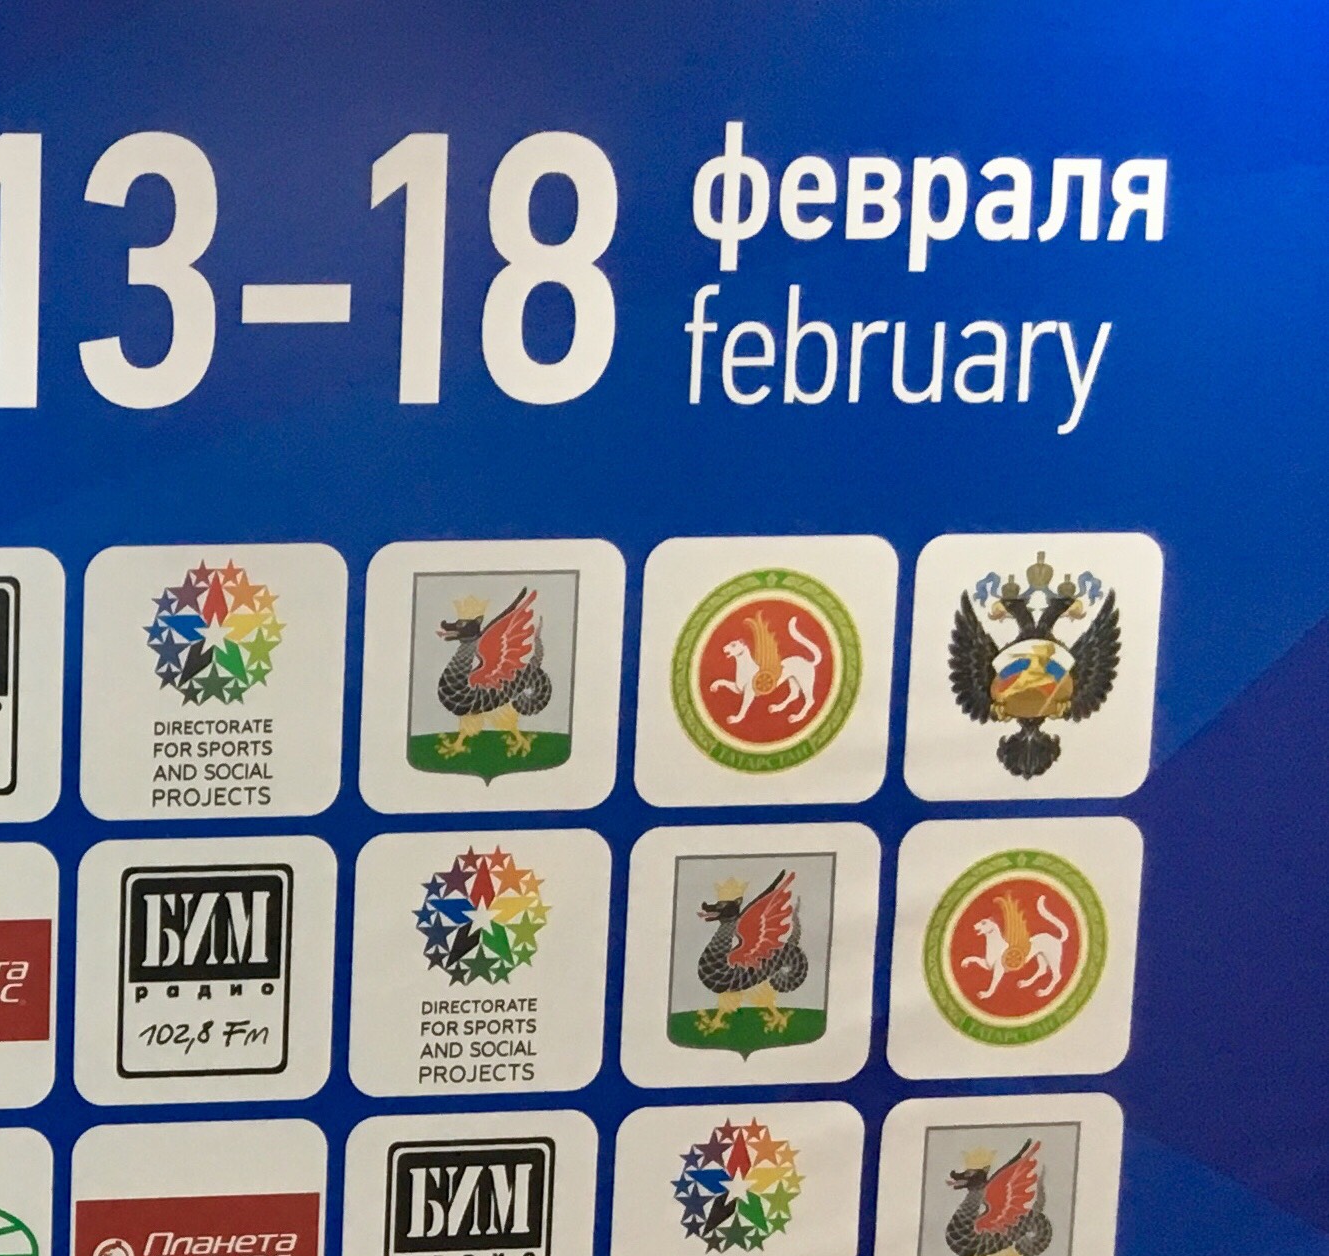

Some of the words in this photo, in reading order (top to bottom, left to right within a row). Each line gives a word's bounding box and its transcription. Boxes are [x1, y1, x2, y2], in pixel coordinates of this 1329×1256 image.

[693, 121, 1167, 272] февраля
[685, 284, 1111, 434] february
[154, 718, 274, 736] DIRECTORATE
[153, 741, 193, 757] FOR
[197, 739, 274, 757] SPORTS
[153, 763, 198, 781] AND
[204, 762, 274, 780] SOCIAL
[152, 786, 272, 807] PROJECTS
[141, 890, 271, 967] БИМ
[135, 982, 275, 1003] радио
[421, 997, 538, 1015] DIRECTORATE
[420, 1020, 459, 1036] FOR
[463, 1017, 537, 1035] SPORTS
[138, 1020, 214, 1056] 102,8
[420, 1041, 463, 1059] AND
[469, 1039, 537, 1058] SOCIAL
[418, 1062, 535, 1084] PROJECTS
[406, 1163, 533, 1239] БИМ
[143, 1227, 297, 1256] Планета
